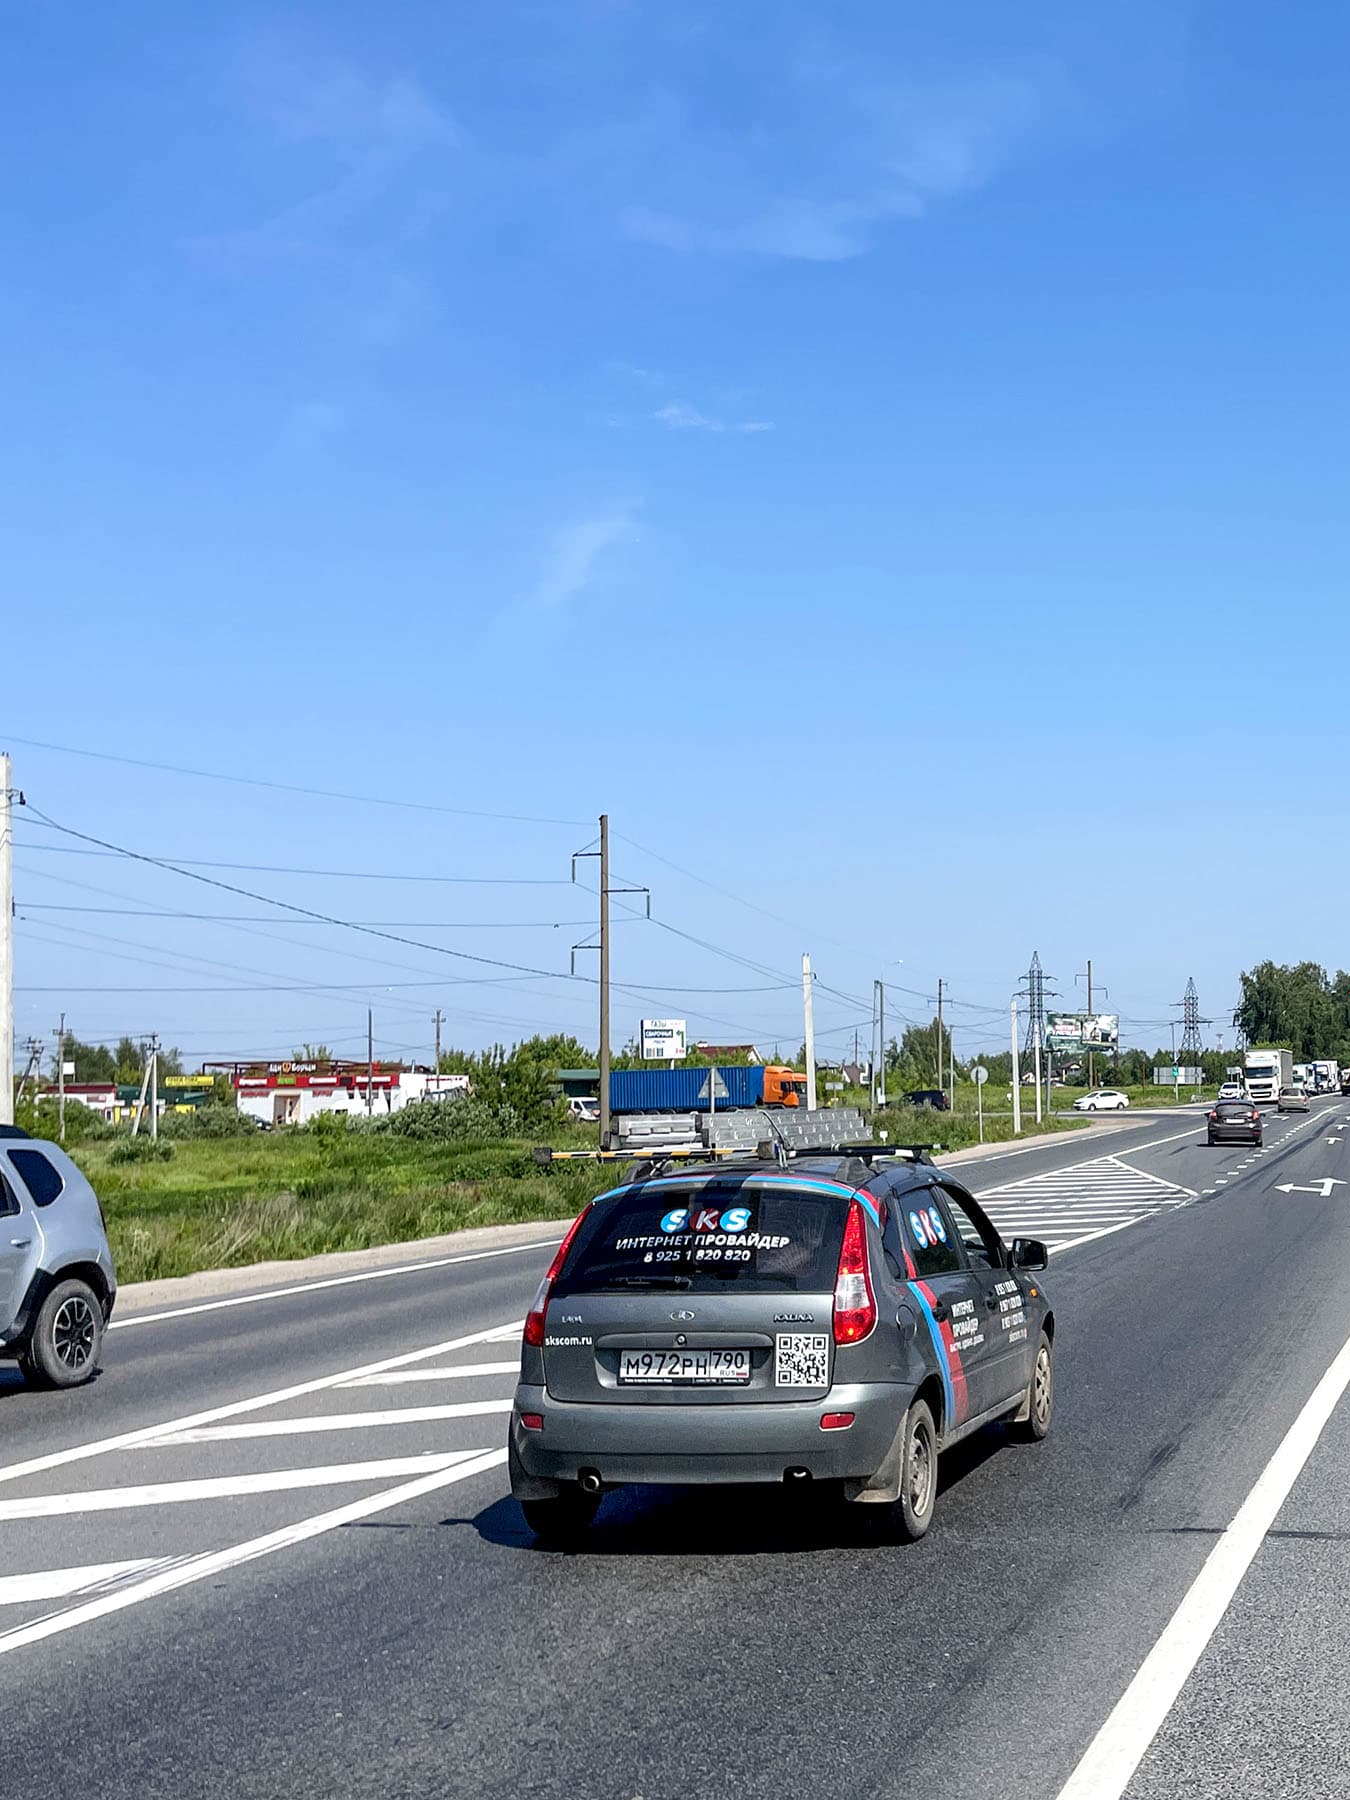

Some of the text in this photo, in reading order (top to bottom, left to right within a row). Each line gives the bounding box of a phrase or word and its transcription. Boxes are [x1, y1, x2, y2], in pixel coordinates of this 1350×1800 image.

[662, 1209, 750, 1232] SKS
[910, 1208, 946, 1248] SKS
[616, 1232, 790, 1250] ИНТЕРНЕТ ПРОВАЙДЕР
[644, 1251, 653, 1262] 8
[656, 1251, 681, 1261] 925
[696, 1250, 721, 1260] 820
[724, 1250, 751, 1261] 820
[545, 1335, 592, 1346] skscom.ru
[712, 1352, 744, 1369] 790
